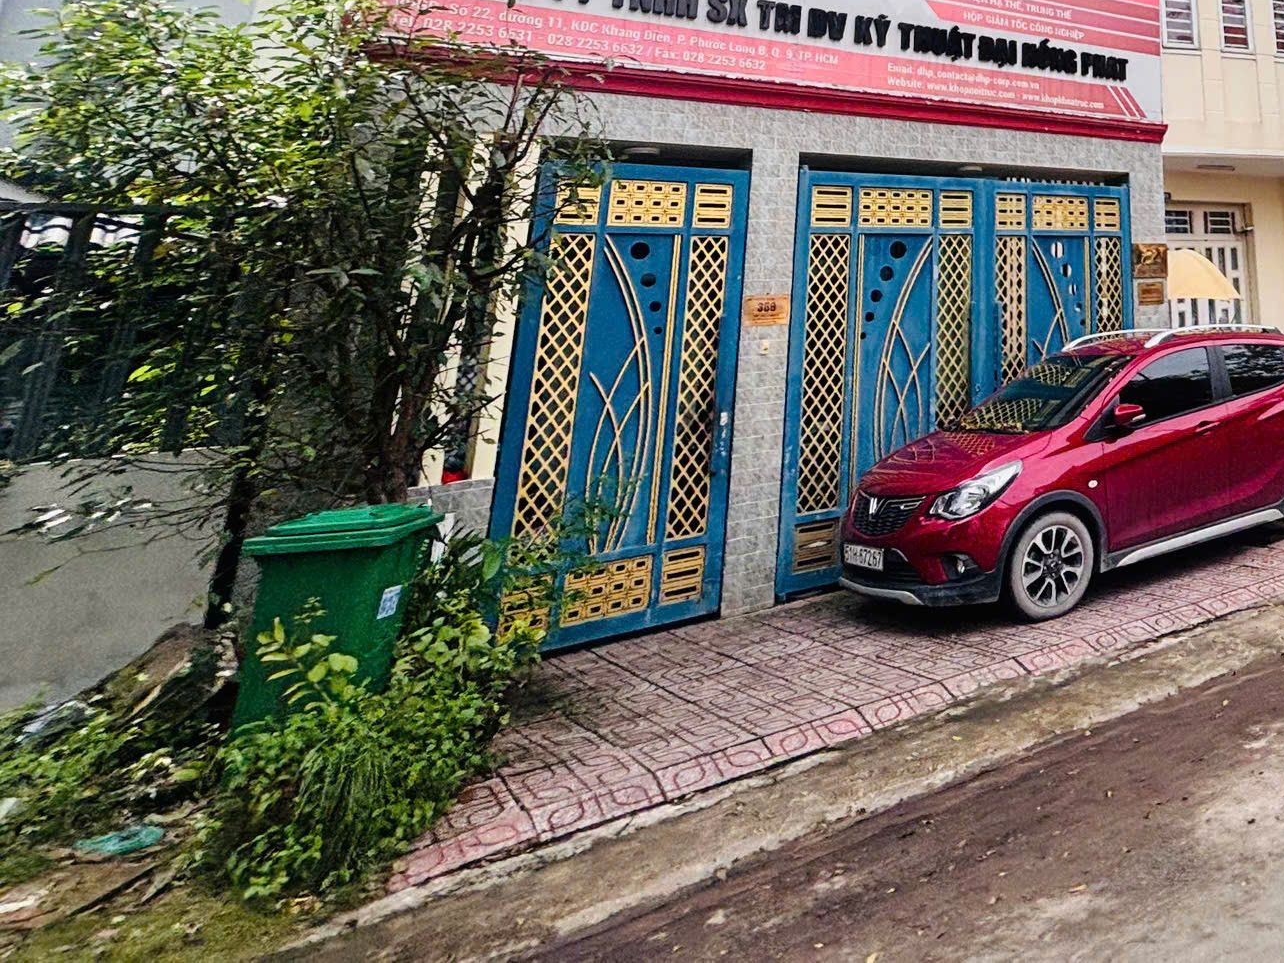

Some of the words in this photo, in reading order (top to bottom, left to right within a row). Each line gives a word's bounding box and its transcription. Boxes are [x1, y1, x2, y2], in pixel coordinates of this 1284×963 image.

[757, 0, 802, 35] TM
[1026, 3, 1054, 17] TRUNG
[458, 20, 494, 37] 2253
[547, 33, 574, 46] 028
[576, 37, 609, 51] 2253
[683, 50, 705, 63] 028
[707, 54, 736, 68] 2253
[738, 58, 767, 71] 6632
[472, 6, 494, 21] 22,
[547, 17, 569, 32] 11,
[601, 24, 641, 41] Khang
[728, 41, 756, 56] Long
[815, 52, 840, 65] HCM
[1029, 23, 1054, 35] CÔNG
[1055, 27, 1085, 41] NGHIỆP
